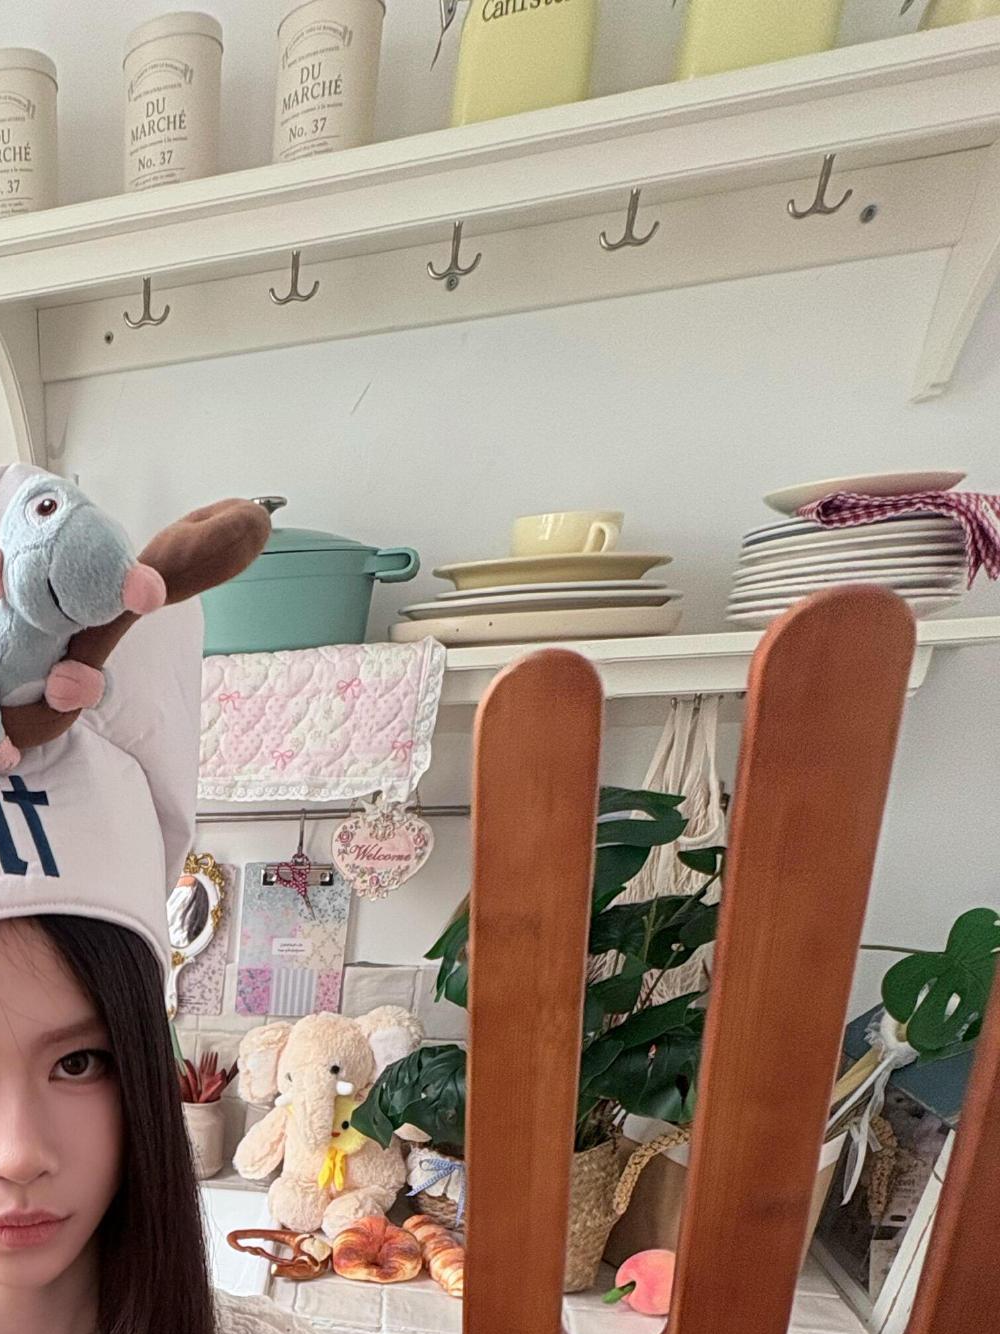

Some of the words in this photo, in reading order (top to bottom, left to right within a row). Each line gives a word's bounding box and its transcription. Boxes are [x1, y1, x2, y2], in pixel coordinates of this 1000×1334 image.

[300, 62, 322, 85] DU
[281, 73, 343, 114] MARCHÉ
[146, 96, 166, 119] DU
[131, 106, 186, 144] MARCHÉ
[288, 124, 307, 142] No.
[312, 117, 327, 135] 37
[138, 155, 156, 172] No.
[160, 149, 173, 166] 37
[7, 179, 20, 194] 37
[349, 843, 412, 861] Welcome
